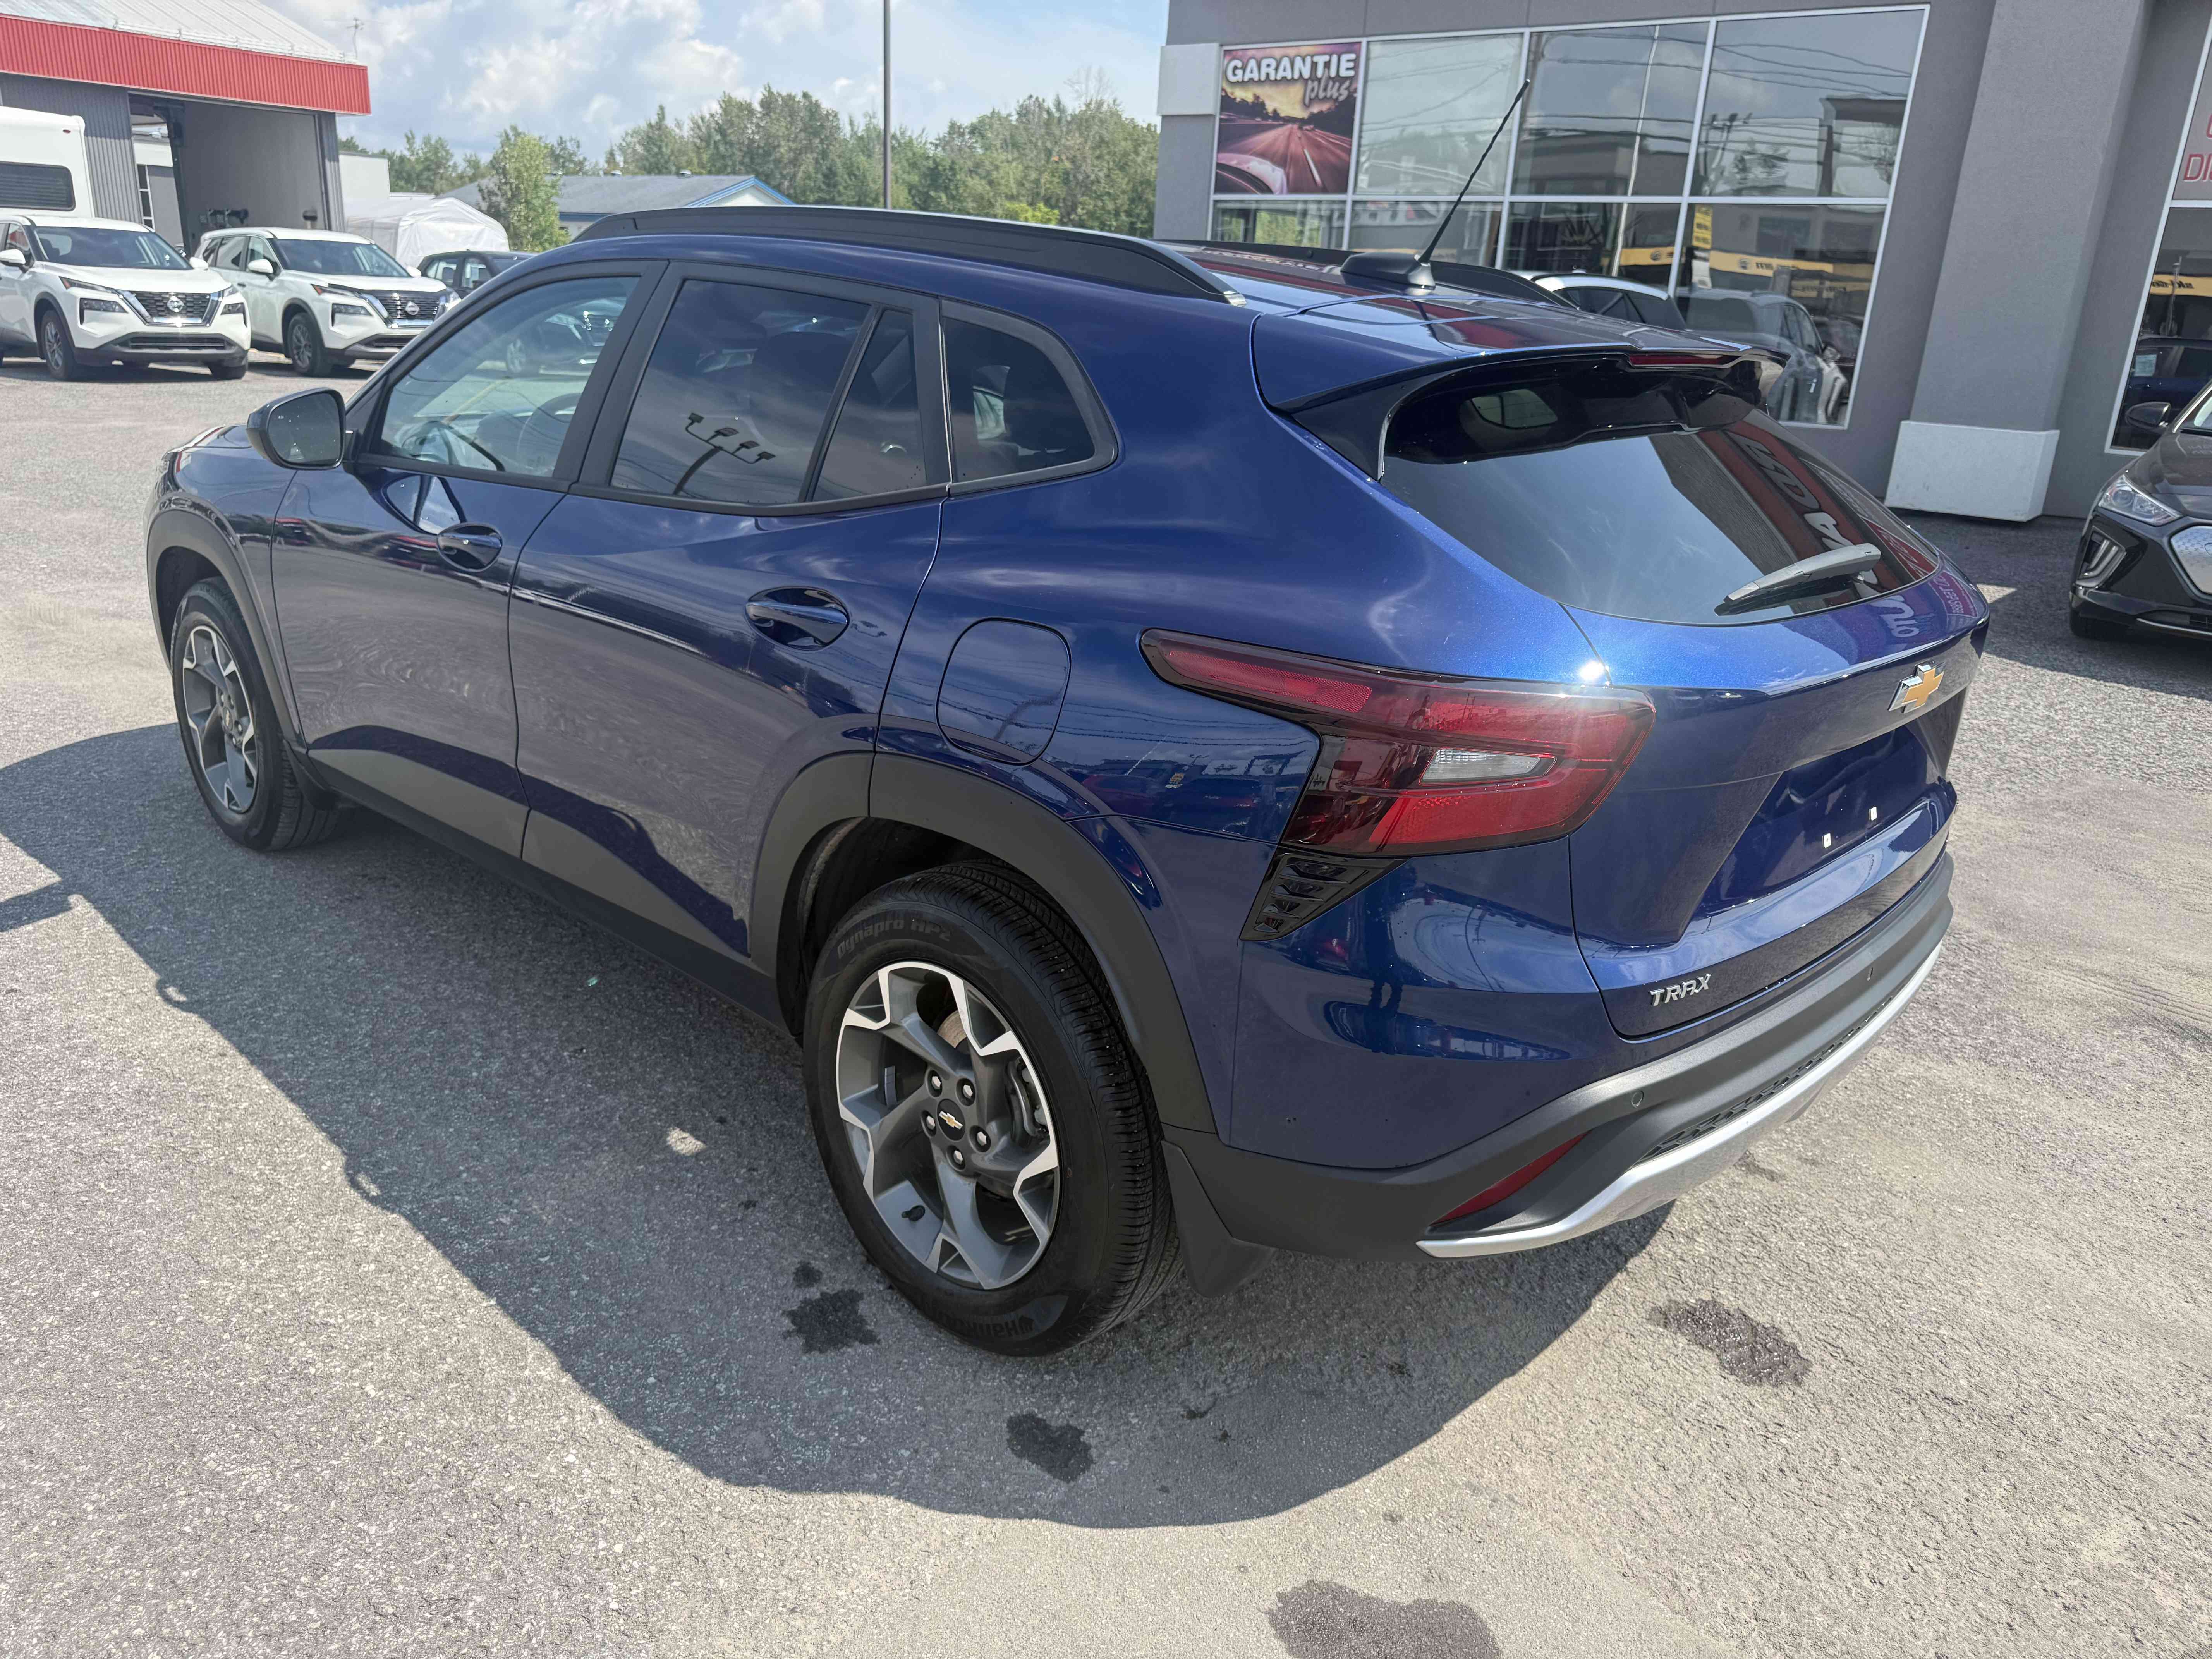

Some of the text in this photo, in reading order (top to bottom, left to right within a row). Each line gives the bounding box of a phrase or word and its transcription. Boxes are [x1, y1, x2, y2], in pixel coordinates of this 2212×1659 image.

[1225, 53, 1357, 83] GARANTIE
[1304, 68, 1351, 108] plus
[837, 919, 905, 960] Dynapro
[1649, 973, 1711, 1006] TRAX
